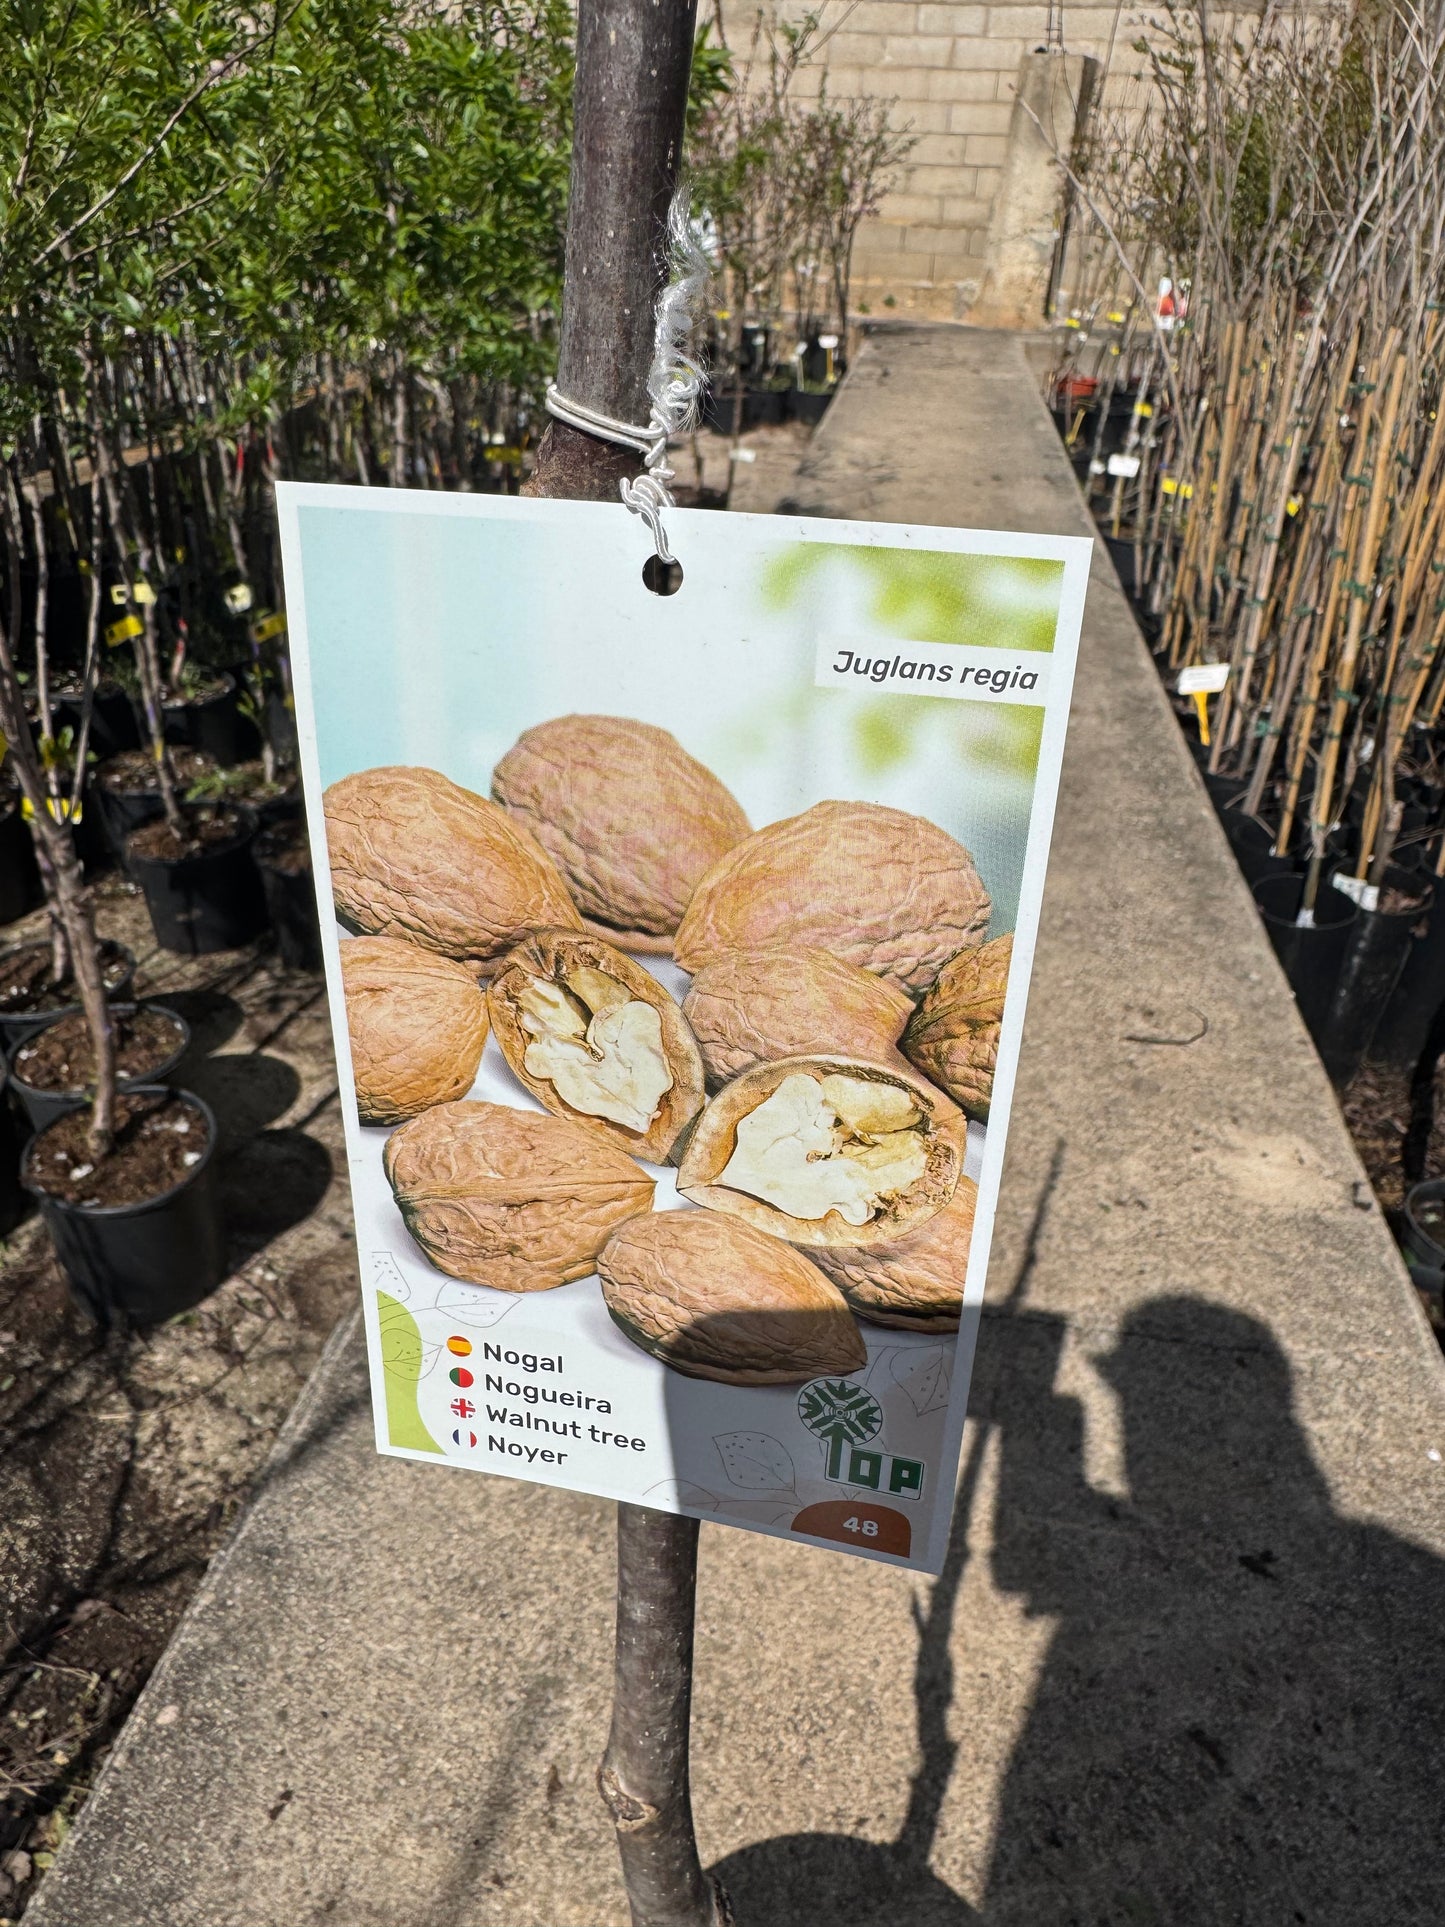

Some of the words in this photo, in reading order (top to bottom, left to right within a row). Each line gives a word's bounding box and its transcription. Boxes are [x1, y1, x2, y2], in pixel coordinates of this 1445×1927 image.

[832, 650, 954, 683] Juglans
[959, 665, 1039, 694] regia
[483, 1342, 564, 1374] Nogal
[486, 1374, 612, 1414] Nogueira
[486, 1404, 582, 1440] Walnut
[587, 1424, 647, 1452] tree
[488, 1435, 569, 1465] Noyer
[842, 1516, 879, 1537] 48
